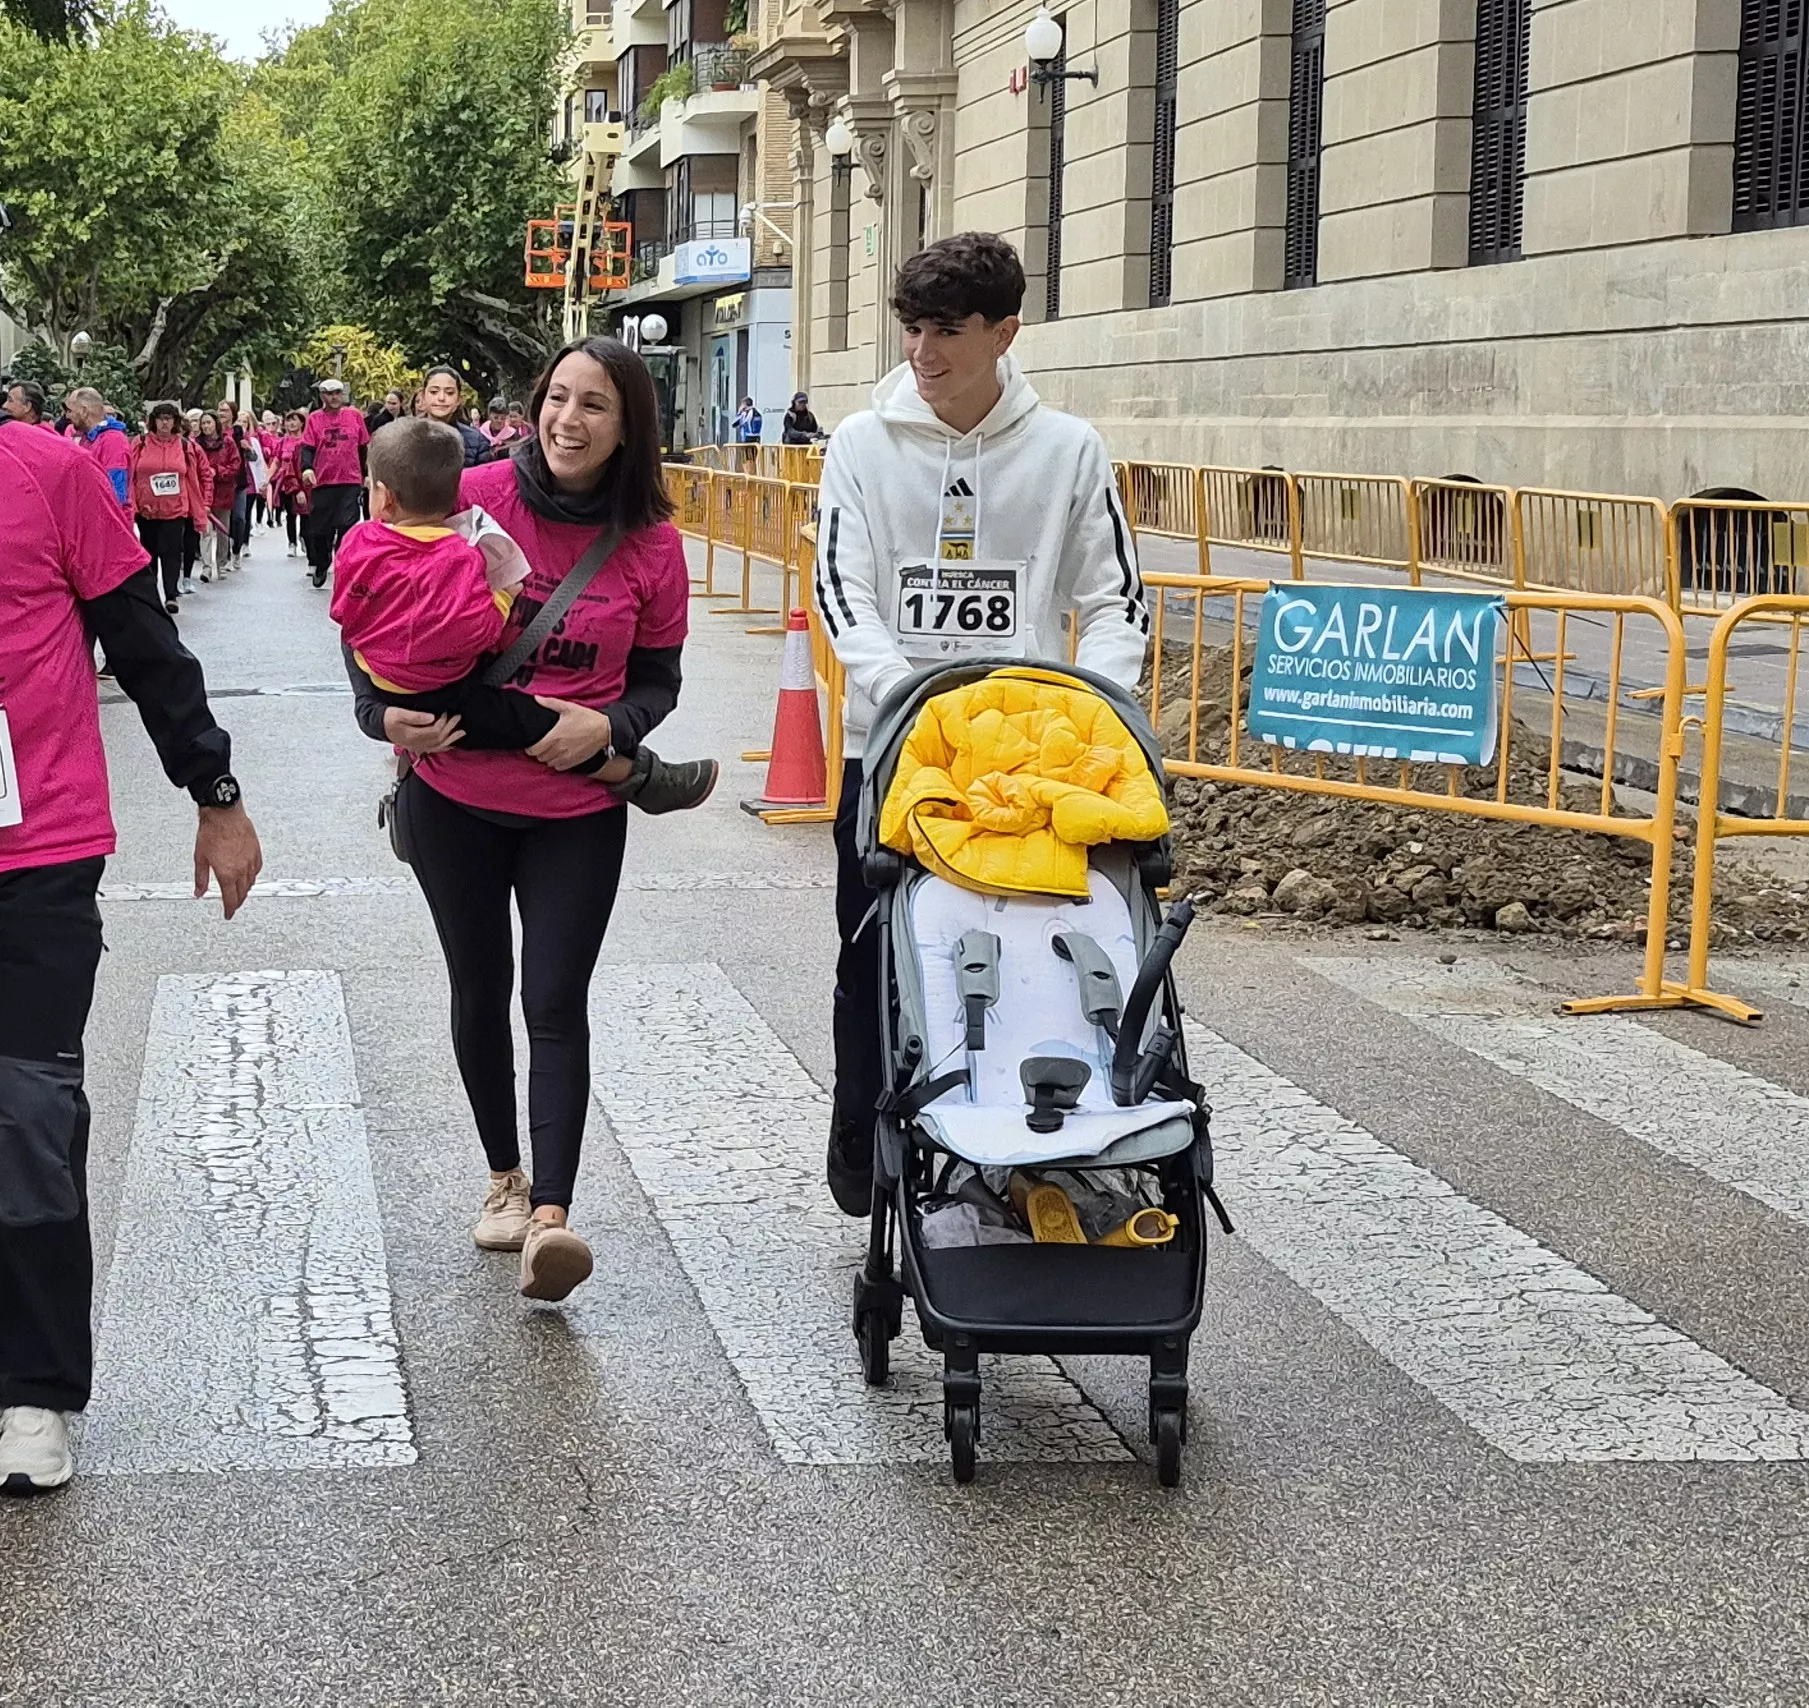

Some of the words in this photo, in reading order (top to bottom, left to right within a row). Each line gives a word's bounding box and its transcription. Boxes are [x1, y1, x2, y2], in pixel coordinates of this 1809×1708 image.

[952, 578, 965, 589] EL
[967, 577, 1010, 591] CÁNCER
[905, 593, 1011, 632] 1768
[1273, 599, 1485, 665] GARLAN
[1267, 653, 1352, 681] SERVICIOS
[1353, 662, 1477, 690] INMOBILIARIOS
[1263, 686, 1473, 720] www.garlaninmobiliaria.com
